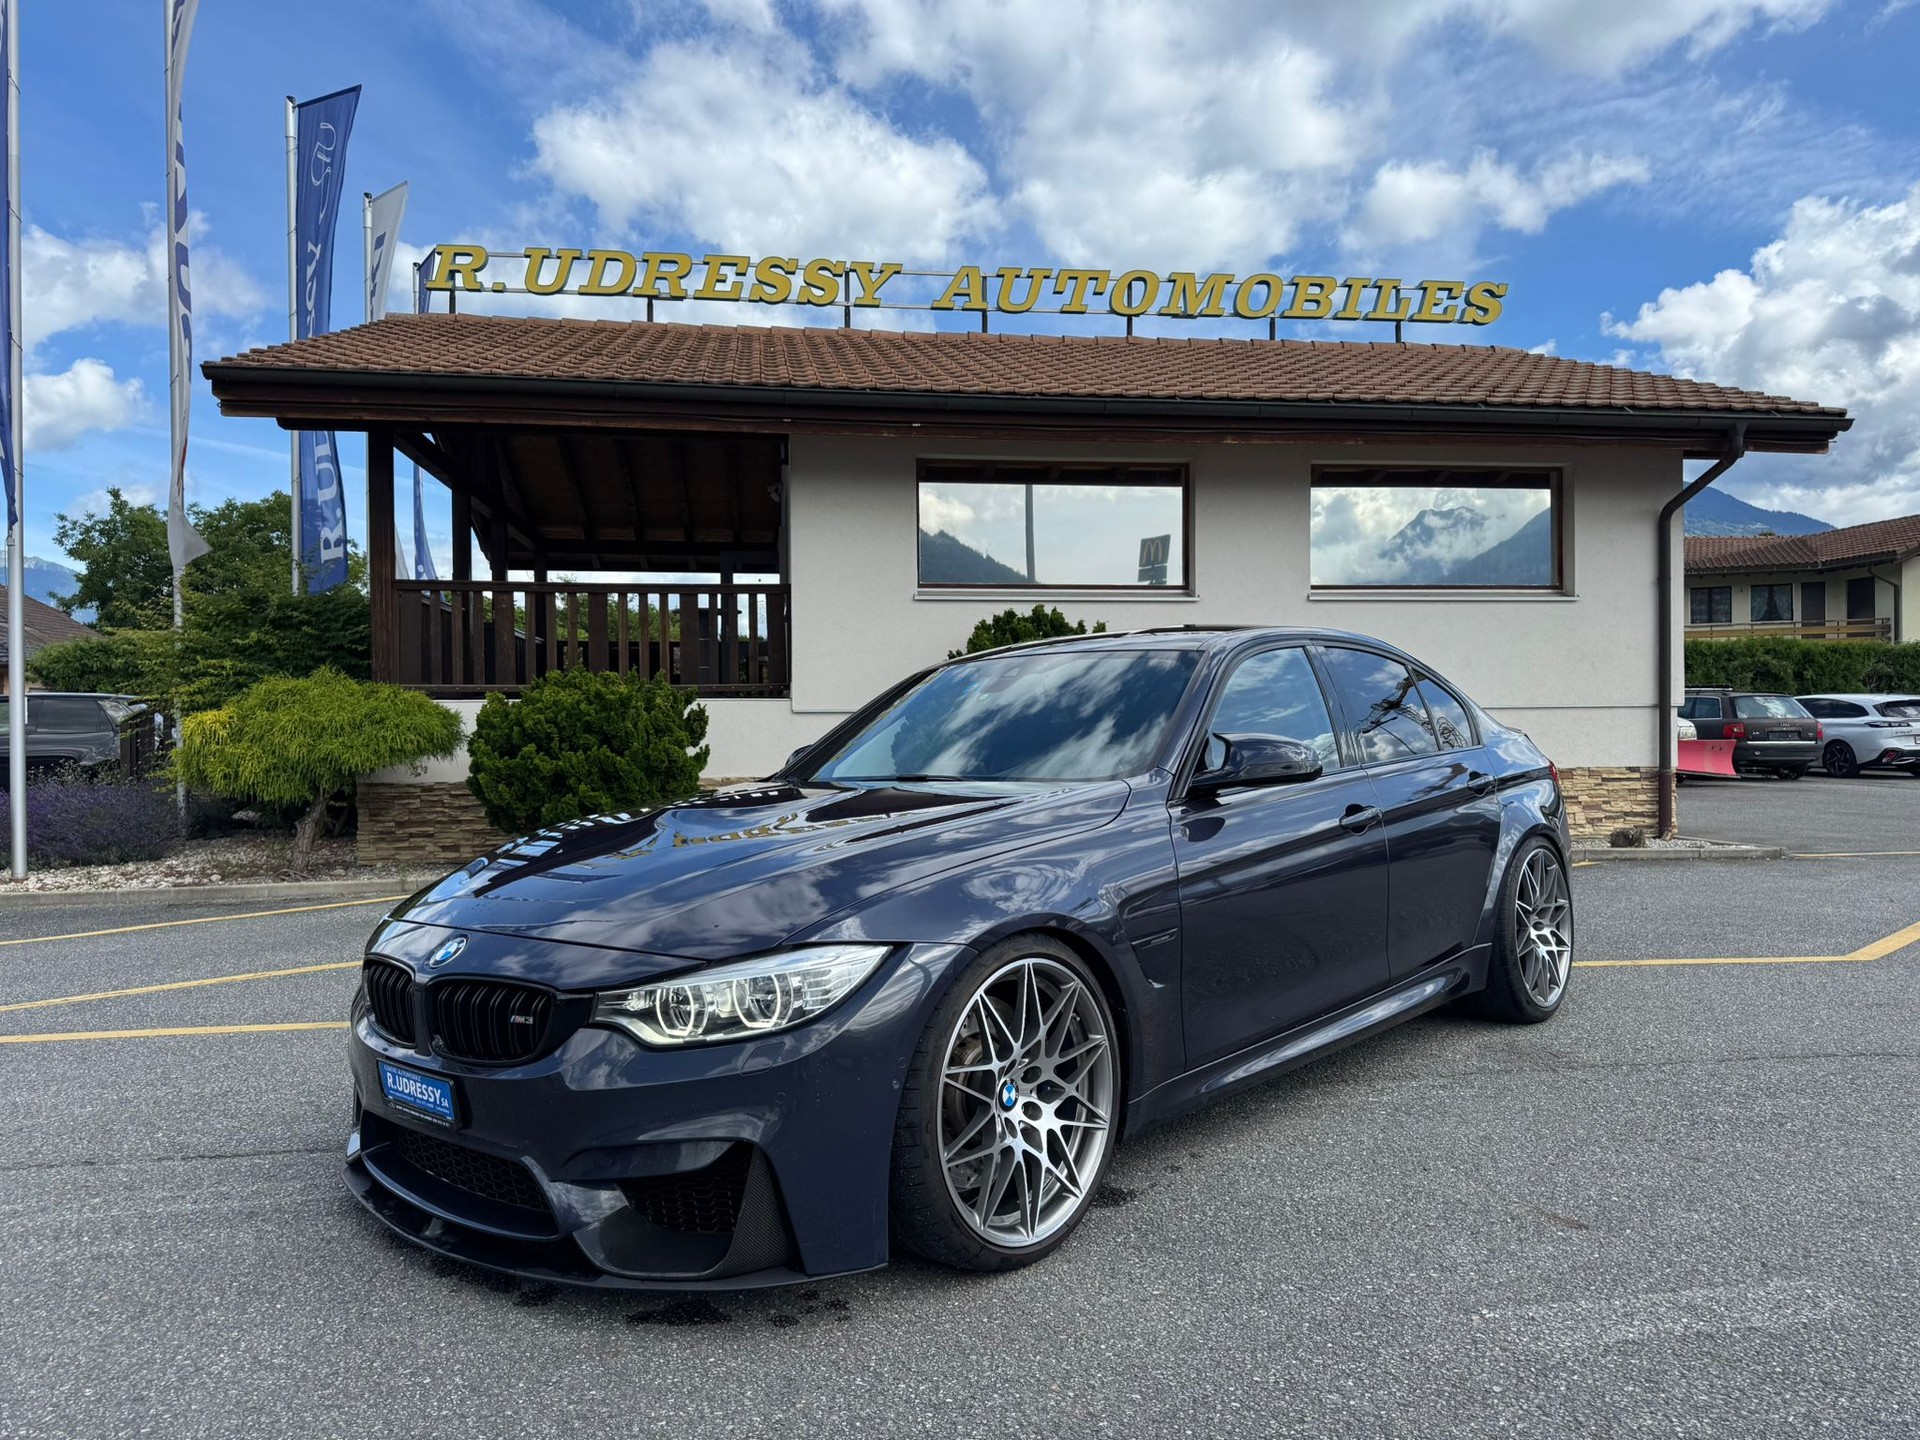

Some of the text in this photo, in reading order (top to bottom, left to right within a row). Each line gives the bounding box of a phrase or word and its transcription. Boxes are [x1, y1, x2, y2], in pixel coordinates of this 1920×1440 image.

[931, 265, 1509, 326] AUTOMOBILES
[387, 1072, 441, 1105] R.UDRESSY
[441, 1097, 449, 1108] SA
